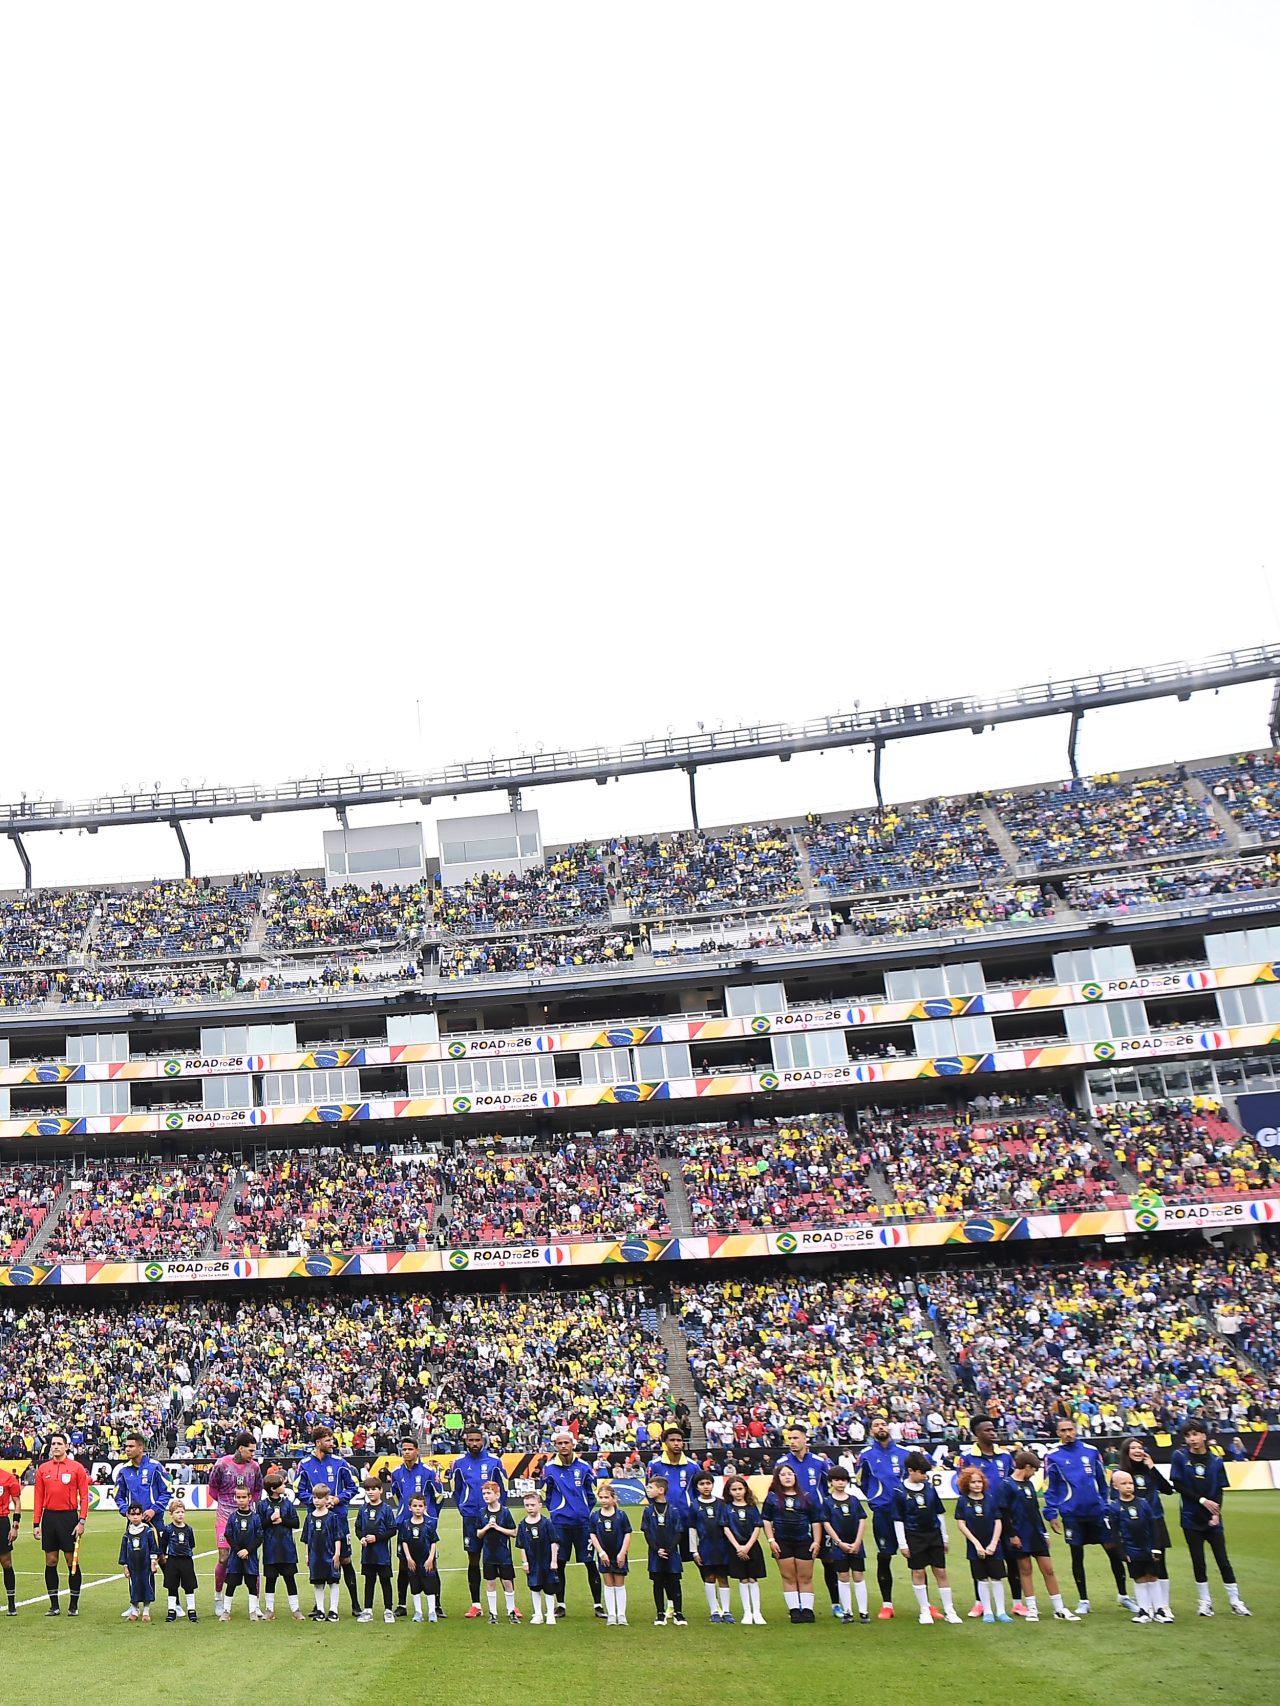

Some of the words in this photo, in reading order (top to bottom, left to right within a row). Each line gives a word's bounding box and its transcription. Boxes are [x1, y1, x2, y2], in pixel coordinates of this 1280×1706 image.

[1108, 979, 1149, 992] ROAD
[1163, 975, 1180, 985] 26
[776, 1013, 813, 1025] ROAD
[825, 1010, 841, 1020] 26
[471, 1040, 505, 1050] ROAD
[516, 1038, 532, 1047] 26
[1121, 1039, 1162, 1051] ROAD
[1176, 1035, 1194, 1045] 26
[185, 1059, 218, 1068] ROAD
[228, 1058, 243, 1066] 26
[784, 1071, 821, 1082] ROAD
[833, 1068, 851, 1077] 26
[476, 1095, 511, 1105] ROAD
[521, 1093, 537, 1102] 26
[187, 1112, 220, 1122] ROAD
[231, 1111, 246, 1120] 26
[1164, 1207, 1209, 1220] ROAD
[1224, 1205, 1243, 1216] 26
[802, 1232, 843, 1243] ROAD
[856, 1230, 874, 1240] 26
[473, 1250, 511, 1260] ROAD
[523, 1249, 540, 1258] 26
[167, 1263, 203, 1273] ROAD
[213, 1262, 230, 1271] 26
